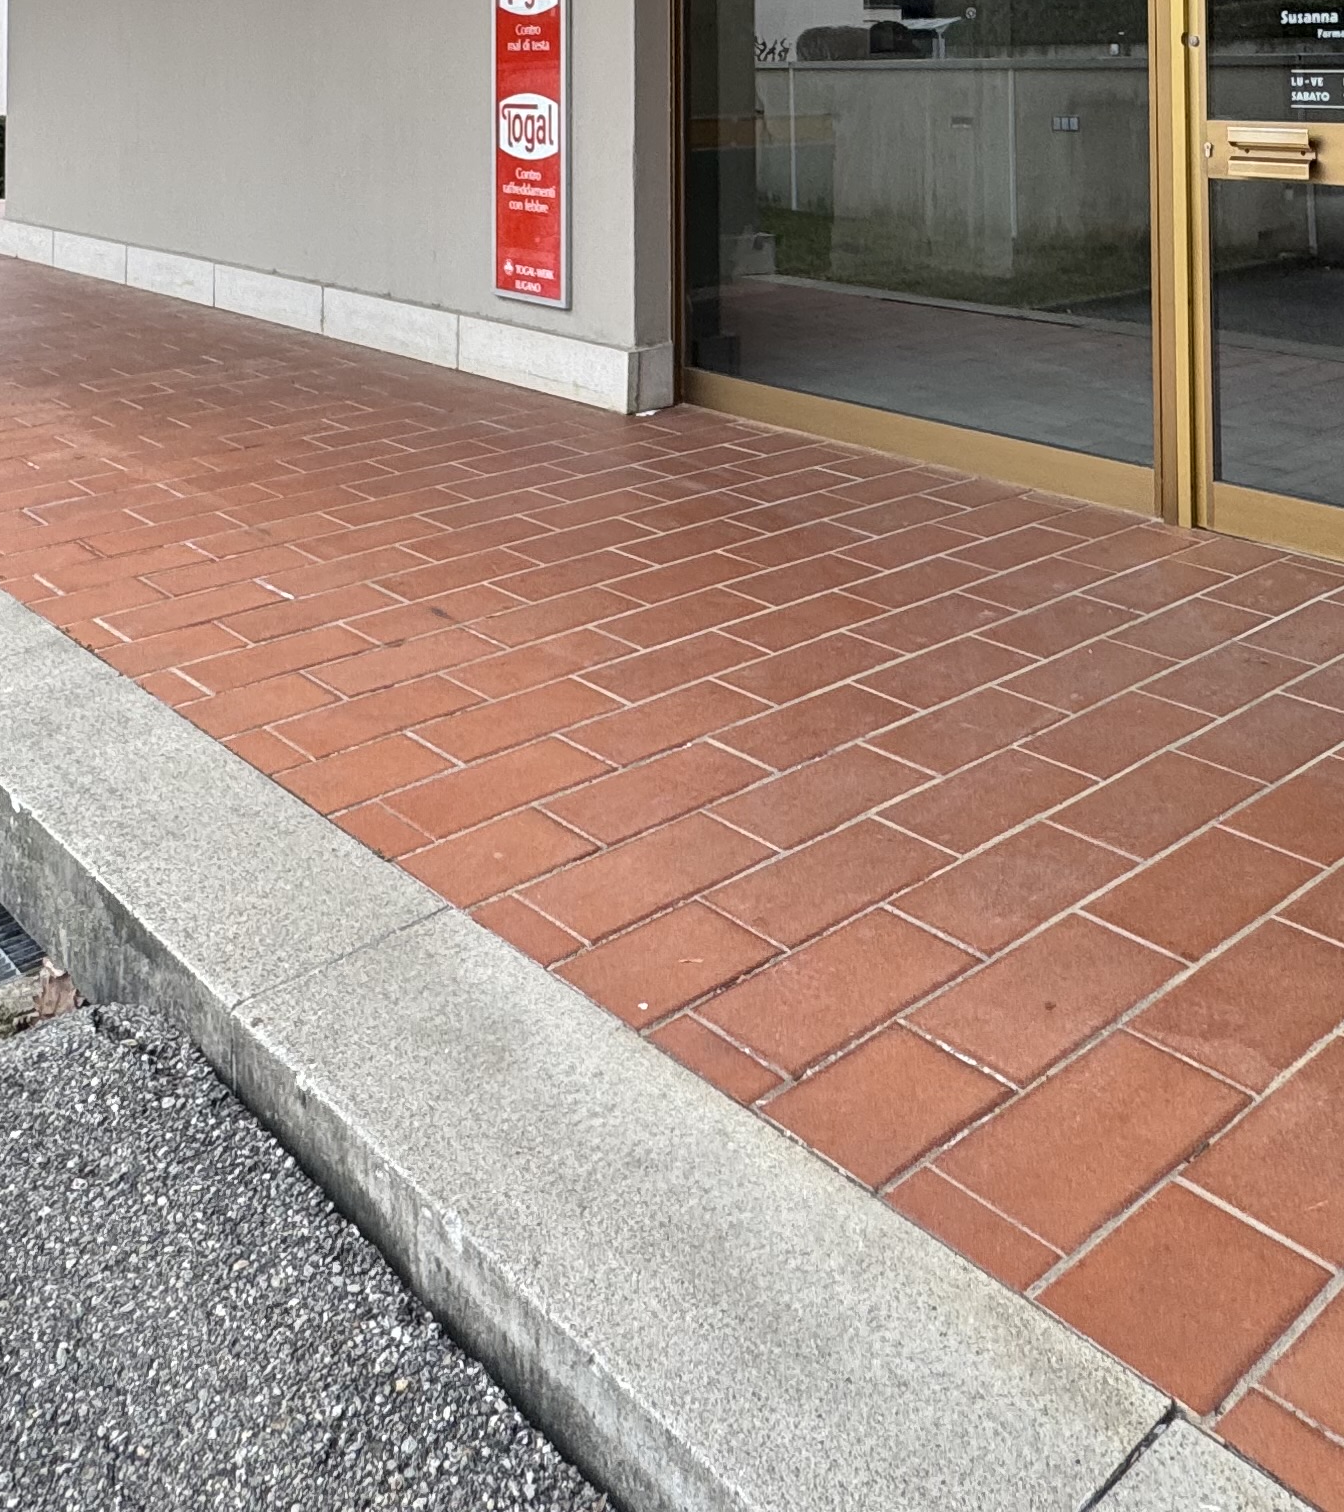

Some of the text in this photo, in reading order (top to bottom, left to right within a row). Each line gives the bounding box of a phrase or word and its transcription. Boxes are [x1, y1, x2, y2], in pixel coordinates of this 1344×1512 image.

[1280, 10, 1339, 24] Susanna
[1290, 76, 1324, 87] LU-VE
[1290, 91, 1331, 102] SABATO
[502, 103, 554, 153] Togal
